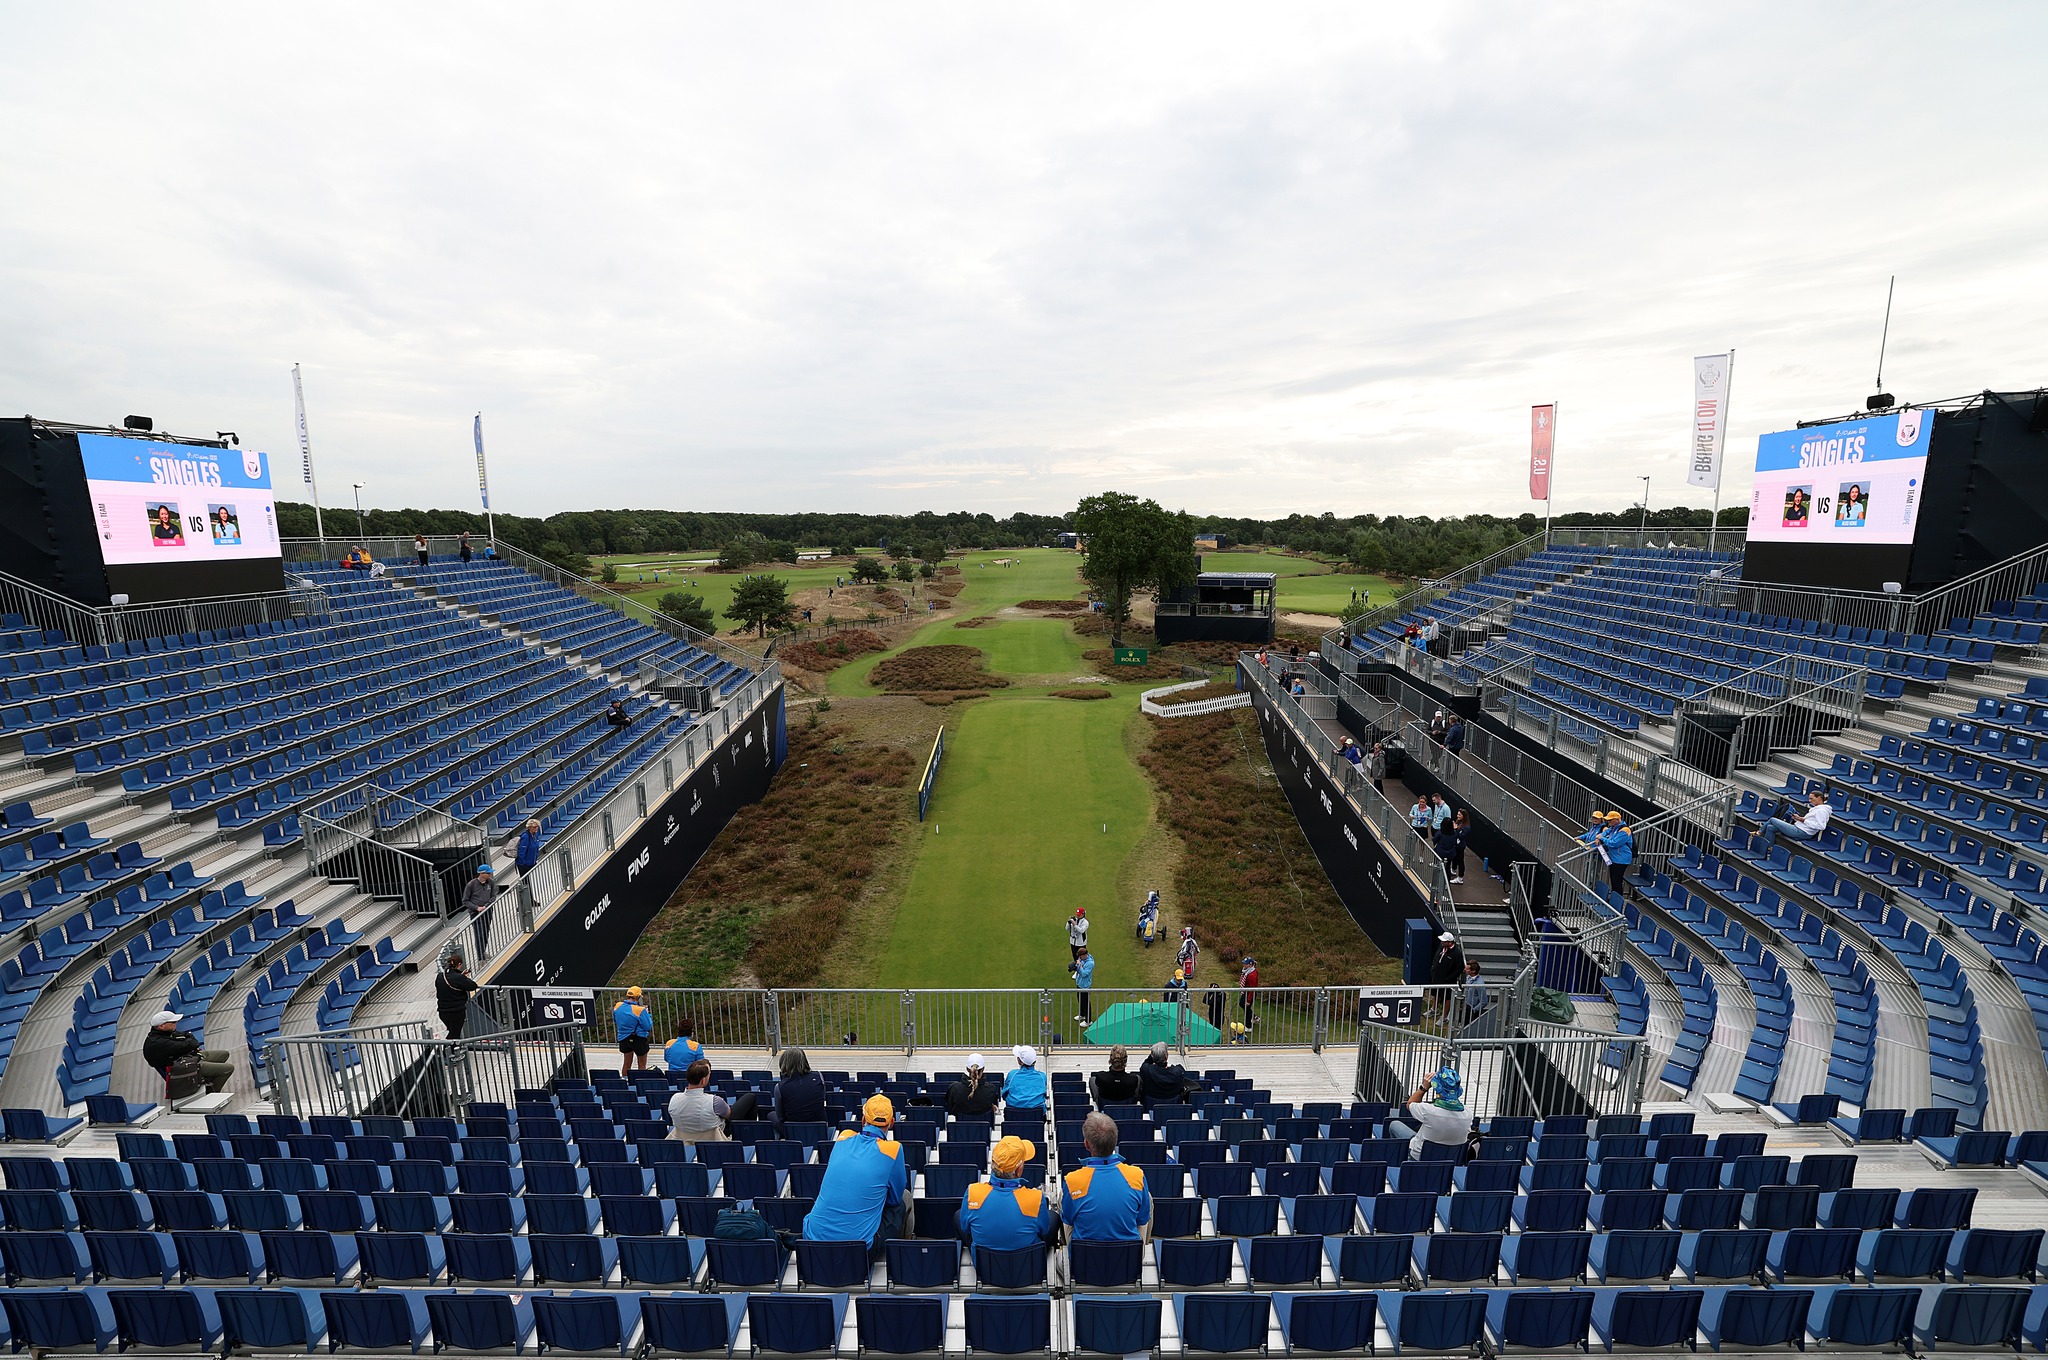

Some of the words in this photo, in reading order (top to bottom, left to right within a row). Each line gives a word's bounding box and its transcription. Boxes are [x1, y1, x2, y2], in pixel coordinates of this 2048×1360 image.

[1799, 436, 1865, 468] SINGLES
[149, 457, 222, 487] SINGLES
[1817, 497, 1831, 514] VS
[1906, 489, 1915, 504] TEAM
[98, 503, 108, 518] TEAM
[188, 516, 204, 533] VS
[627, 846, 650, 883] PING
[584, 893, 611, 931] GOLF.NL
